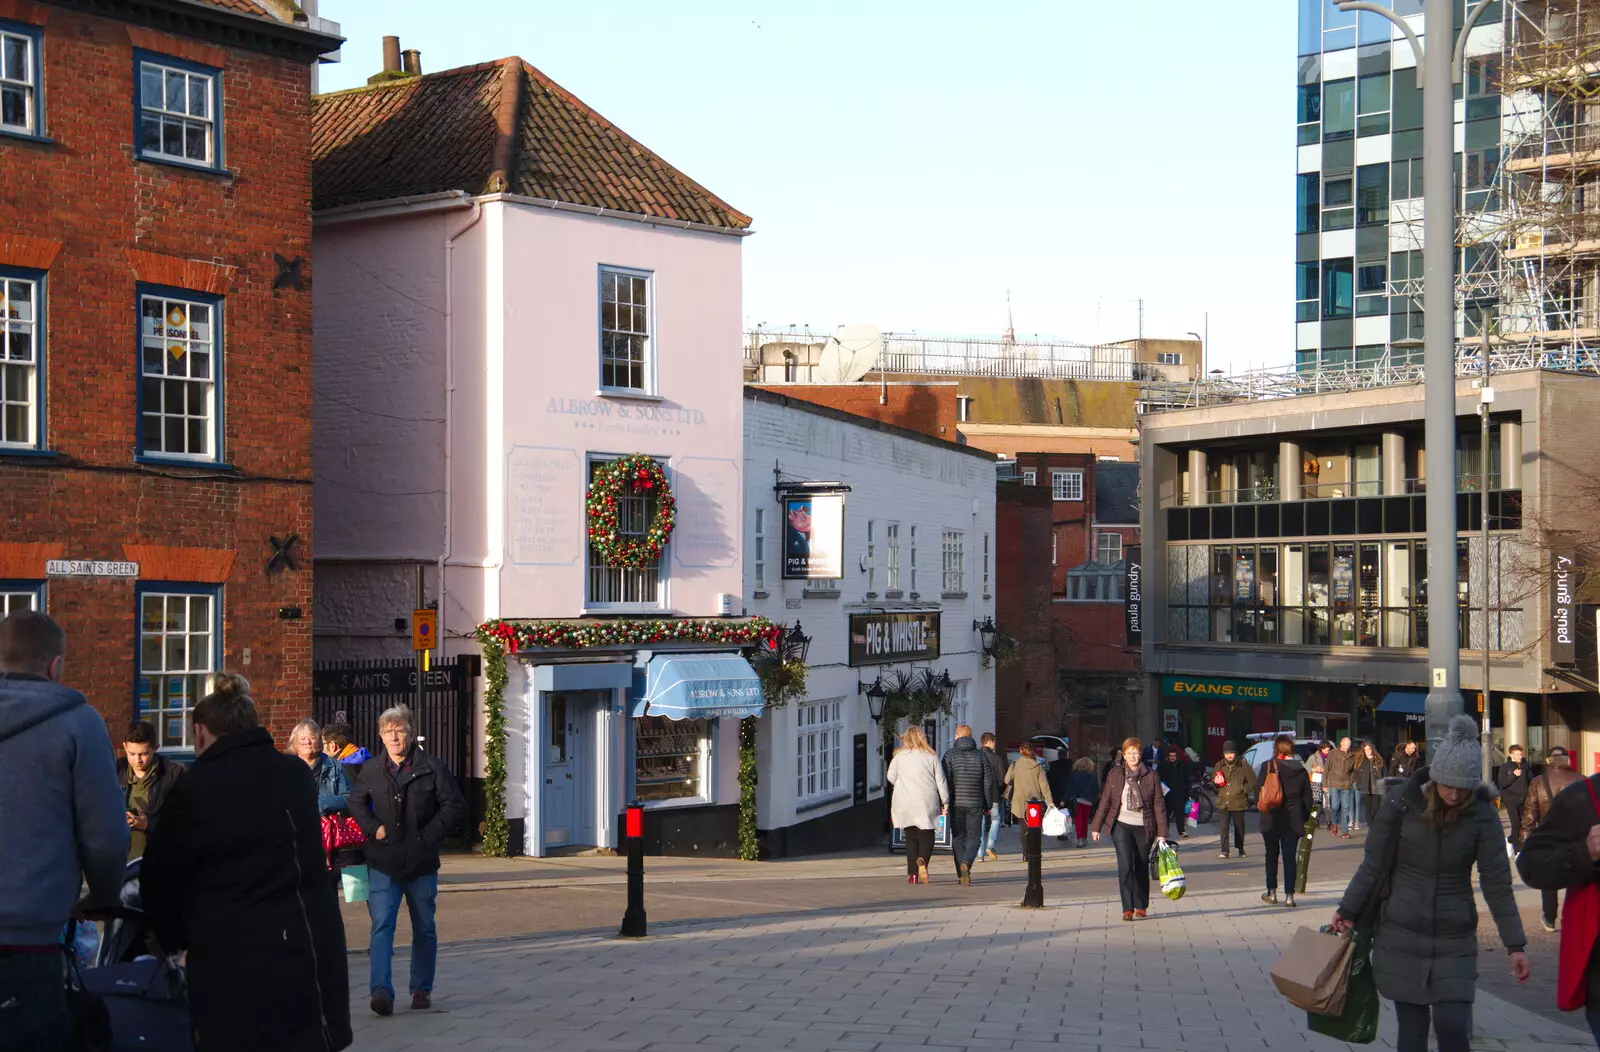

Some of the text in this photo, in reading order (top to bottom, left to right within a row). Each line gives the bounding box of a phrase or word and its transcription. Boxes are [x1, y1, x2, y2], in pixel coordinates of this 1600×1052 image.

[153, 327, 200, 340] PESONEL
[547, 397, 613, 417] ALBROW
[618, 402, 632, 419] &
[636, 404, 673, 422] SONS
[49, 562, 136, 575] ALL SAINTS GREEN
[788, 558, 800, 566] PIG
[1127, 562, 1142, 632] paula gundry
[1553, 555, 1572, 644] paula gundry
[866, 620, 927, 655] PIG & WHISTLE
[341, 673, 391, 690] SAINTS
[408, 670, 451, 687] GEEN
[690, 689, 718, 699] ALBROW
[719, 687, 726, 697] &
[728, 688, 745, 697] SONS
[1173, 681, 1269, 697] EVANS CYCLES
[1405, 714, 1417, 722] paula
[1207, 727, 1225, 736] SALE
